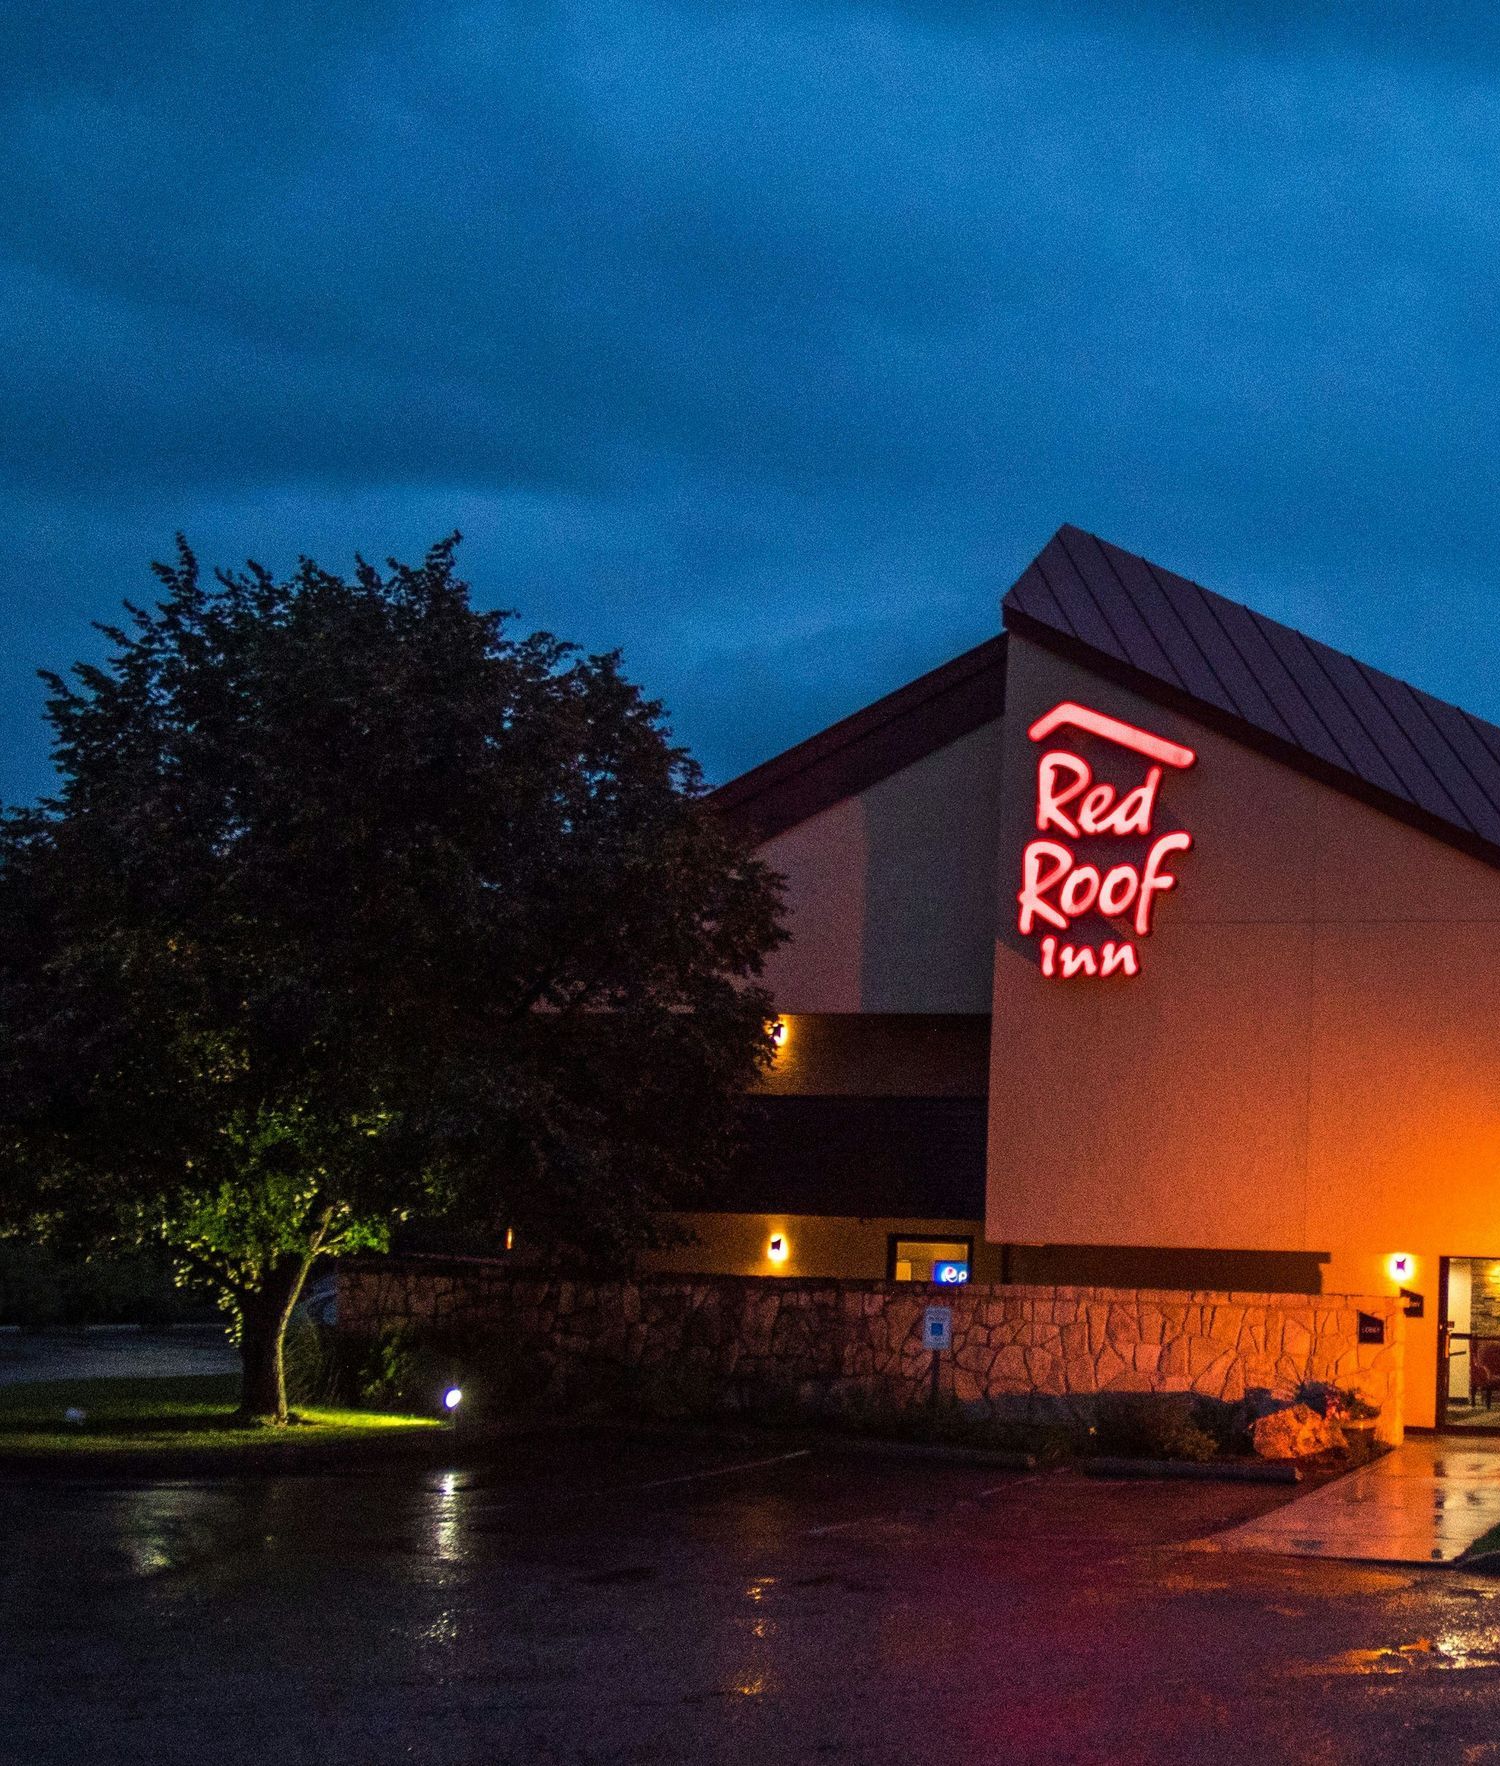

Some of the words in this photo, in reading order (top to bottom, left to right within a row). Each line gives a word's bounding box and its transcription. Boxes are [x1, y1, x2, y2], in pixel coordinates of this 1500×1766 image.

[1037, 752, 1161, 837] Red
[1017, 832, 1191, 935] Roof
[1040, 935, 1139, 978] Inn
